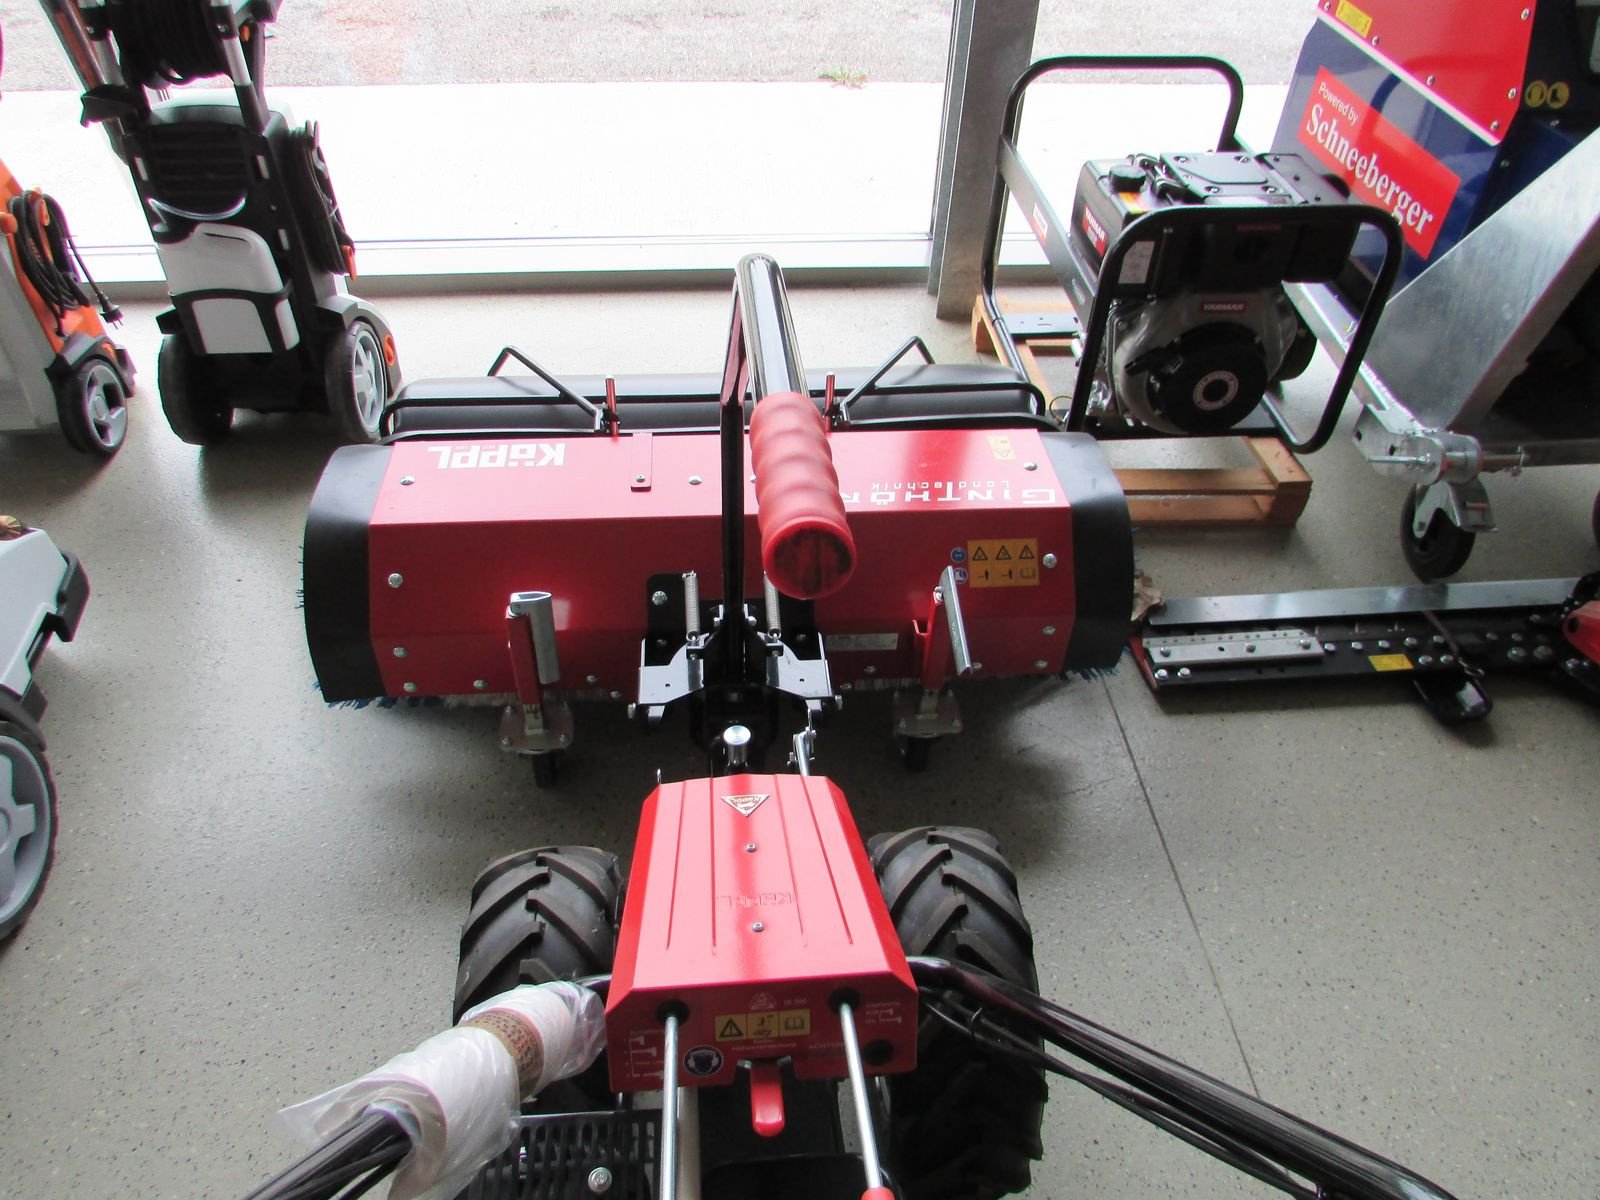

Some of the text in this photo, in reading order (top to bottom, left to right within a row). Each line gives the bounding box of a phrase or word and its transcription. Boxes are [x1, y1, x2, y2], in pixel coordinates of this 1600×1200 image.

[1318, 81, 1359, 126] Powered by
[1306, 103, 1433, 235] Schneeberger
